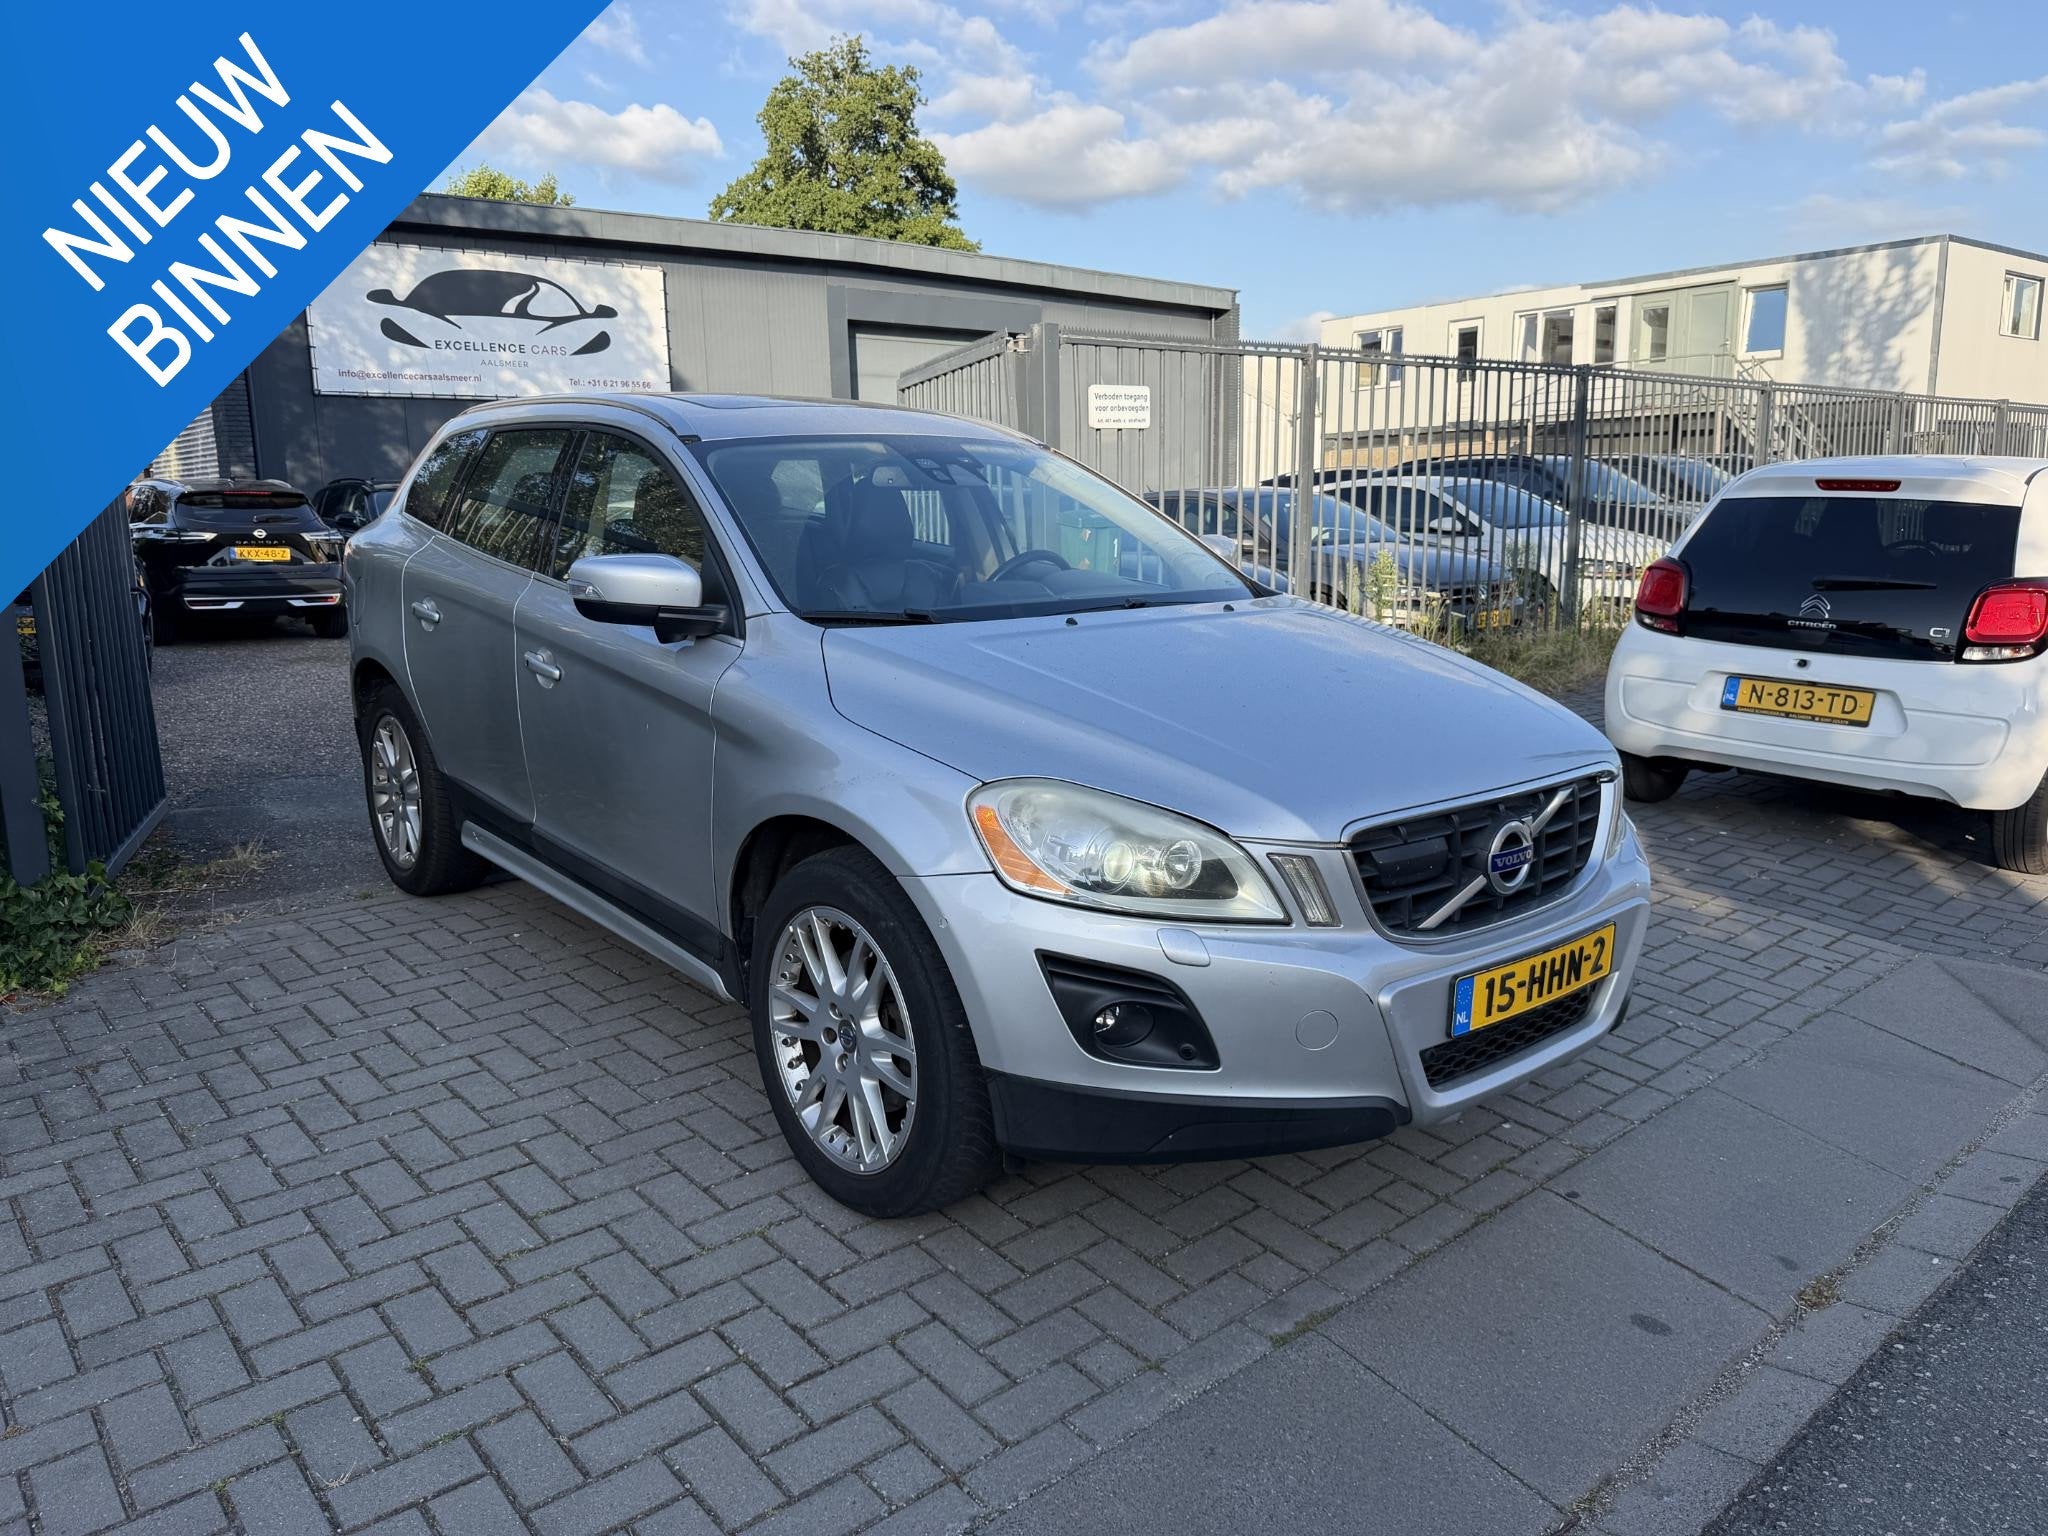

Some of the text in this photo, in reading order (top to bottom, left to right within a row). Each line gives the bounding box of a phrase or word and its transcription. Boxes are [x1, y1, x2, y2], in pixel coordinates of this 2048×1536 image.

[434, 339, 567, 356] EXCELLENCE CARS
[480, 359, 529, 368] AALSMEER
[1124, 393, 1148, 402] toegang
[239, 549, 287, 558] KKX-48-Z
[1748, 683, 1859, 715] N-813-TD
[1494, 849, 1532, 867] VOLVO
[1456, 936, 1606, 1025] NL 15-HHN-2
